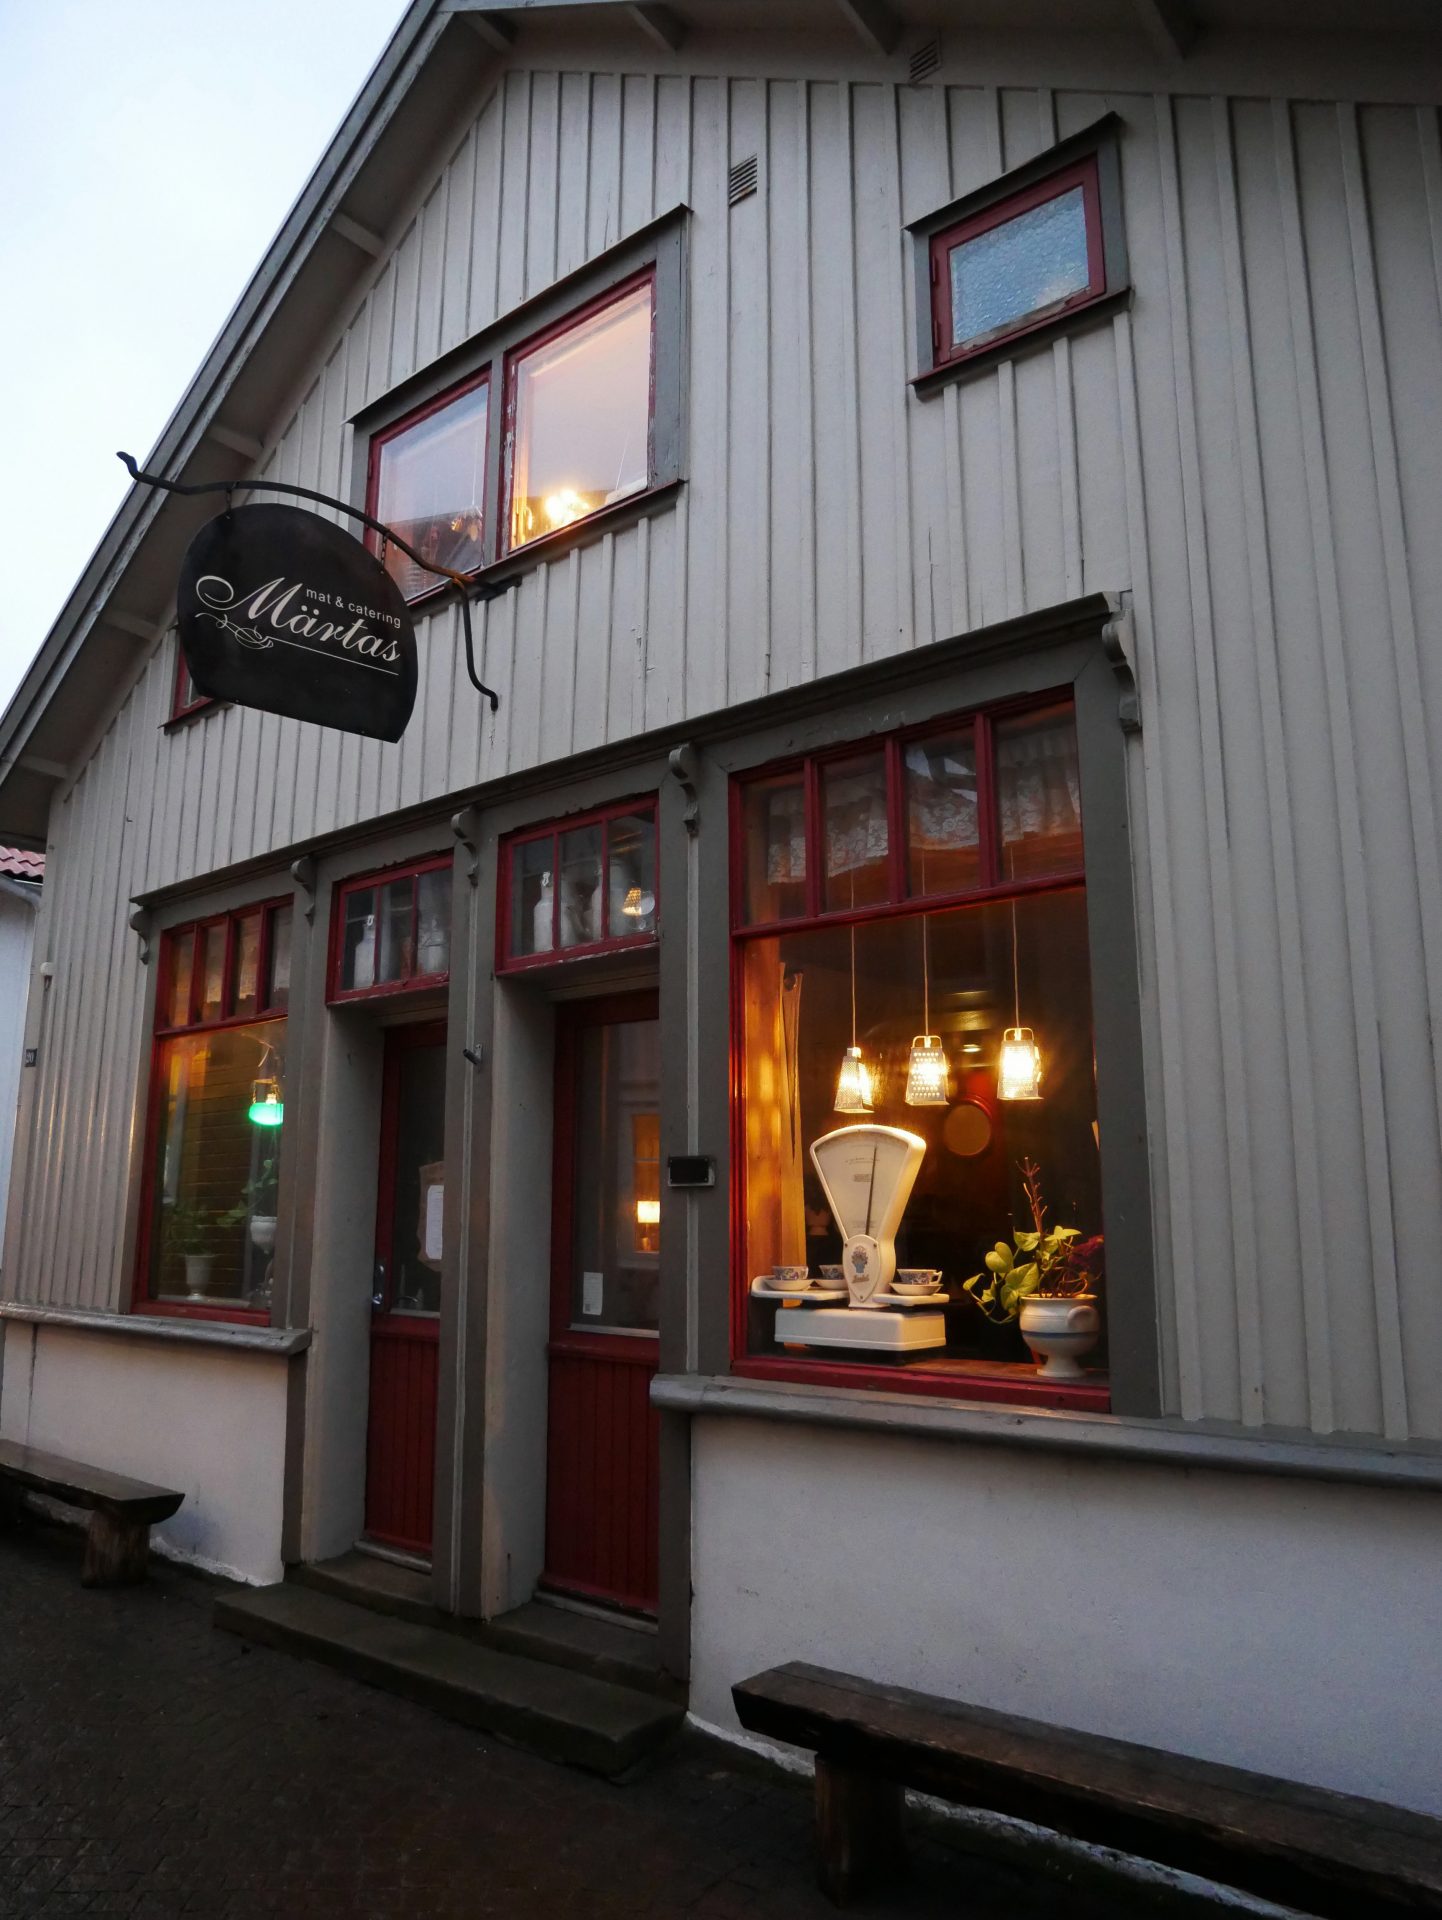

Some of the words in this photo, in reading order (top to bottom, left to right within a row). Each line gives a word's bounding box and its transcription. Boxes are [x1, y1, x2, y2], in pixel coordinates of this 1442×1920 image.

[196, 575, 401, 662] Märtas
[306, 588, 331, 604] mat
[335, 596, 344, 609] &
[348, 602, 401, 629] catering
